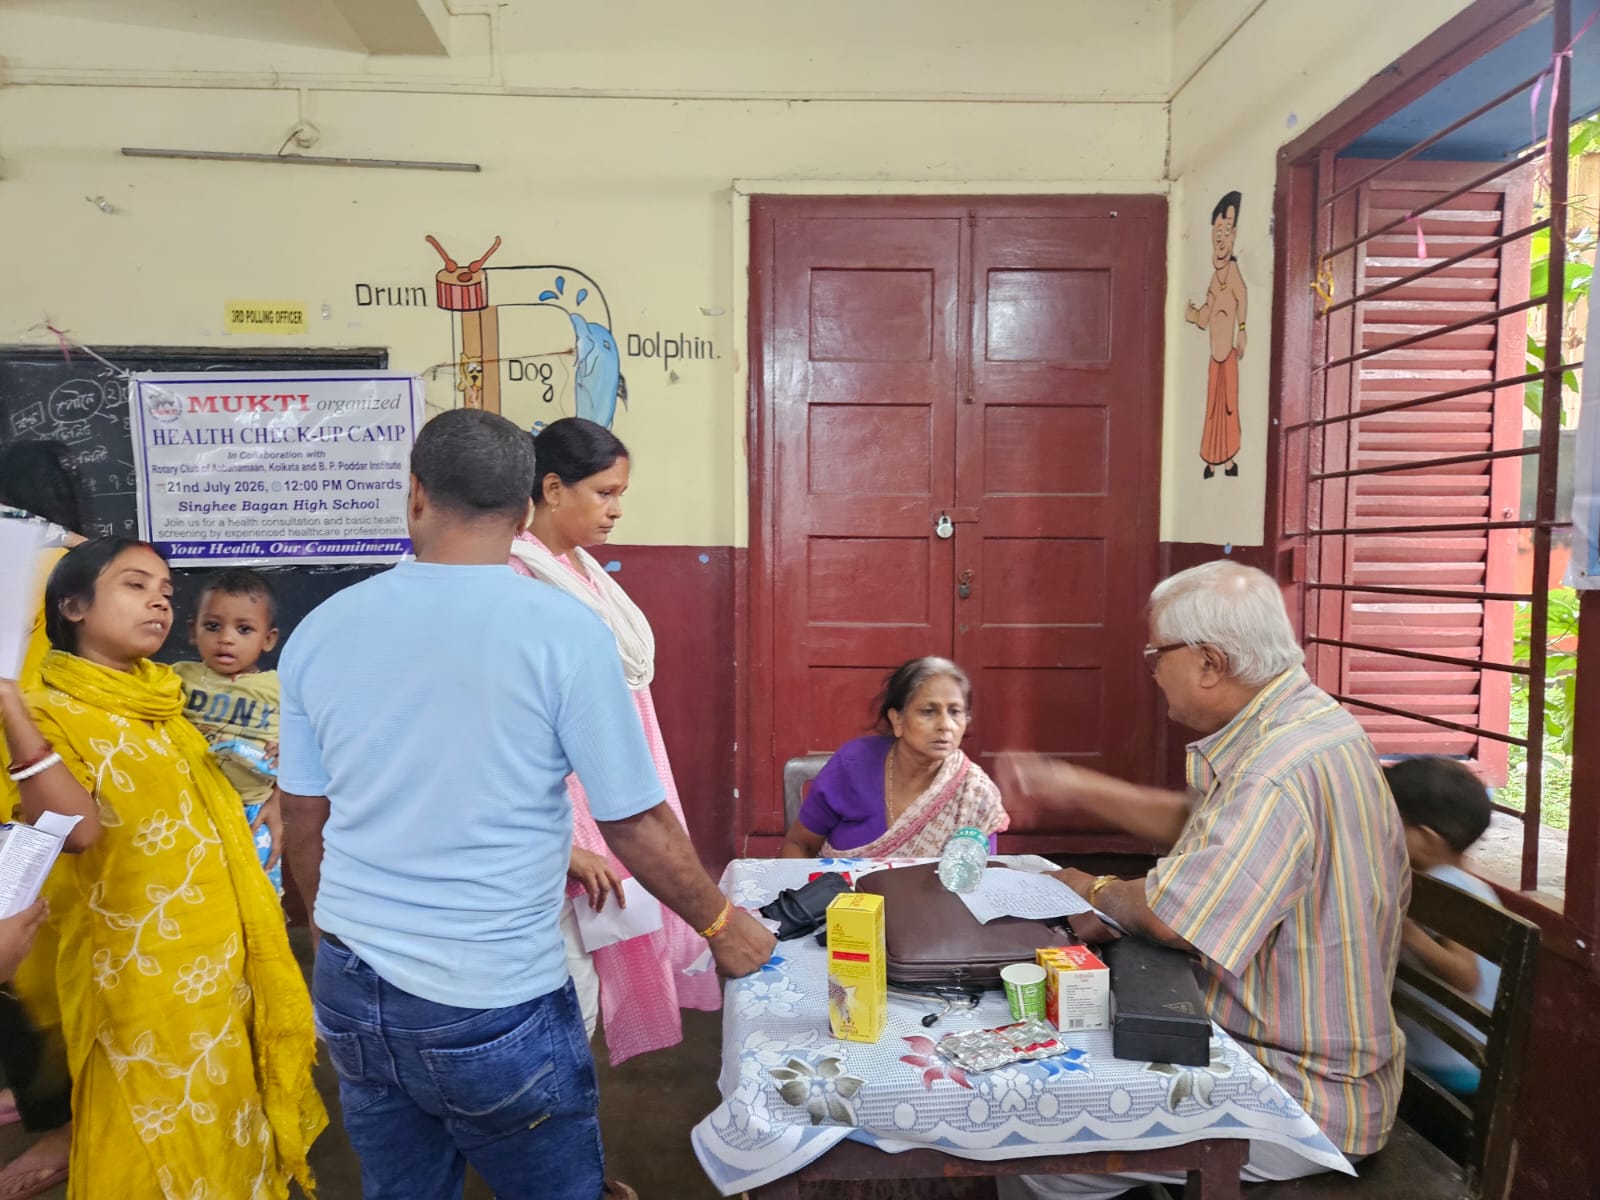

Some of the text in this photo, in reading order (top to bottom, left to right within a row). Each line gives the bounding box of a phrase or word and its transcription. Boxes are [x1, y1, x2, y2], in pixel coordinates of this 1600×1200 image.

[355, 283, 428, 307] Drum
[231, 309, 303, 325] 3RD POLLING OFFICER
[508, 359, 554, 403] Dog
[187, 393, 312, 414] MUKTI
[316, 393, 402, 415] organized
[152, 425, 406, 446] HEALTH CHECK-UP CAMP
[227, 450, 326, 461] In Collaboration with
[151, 463, 179, 476] Rotary
[301, 461, 318, 472] and
[338, 460, 368, 471] Poddar
[167, 479, 403, 495] 21nd July 2026, 12:00 PM Onwards
[178, 498, 380, 514] Singhee Bagan High School
[163, 518, 185, 528] Join
[187, 519, 200, 527] us
[202, 518, 215, 527] for
[228, 517, 258, 527] health
[261, 517, 321, 527] consultation
[323, 516, 342, 526] and
[345, 516, 371, 526] basic
[158, 529, 207, 539] screening
[209, 529, 222, 539] by
[224, 528, 285, 539] experienced
[288, 527, 341, 537] healthcare
[170, 541, 405, 555] Your Health, Our Commitment.
